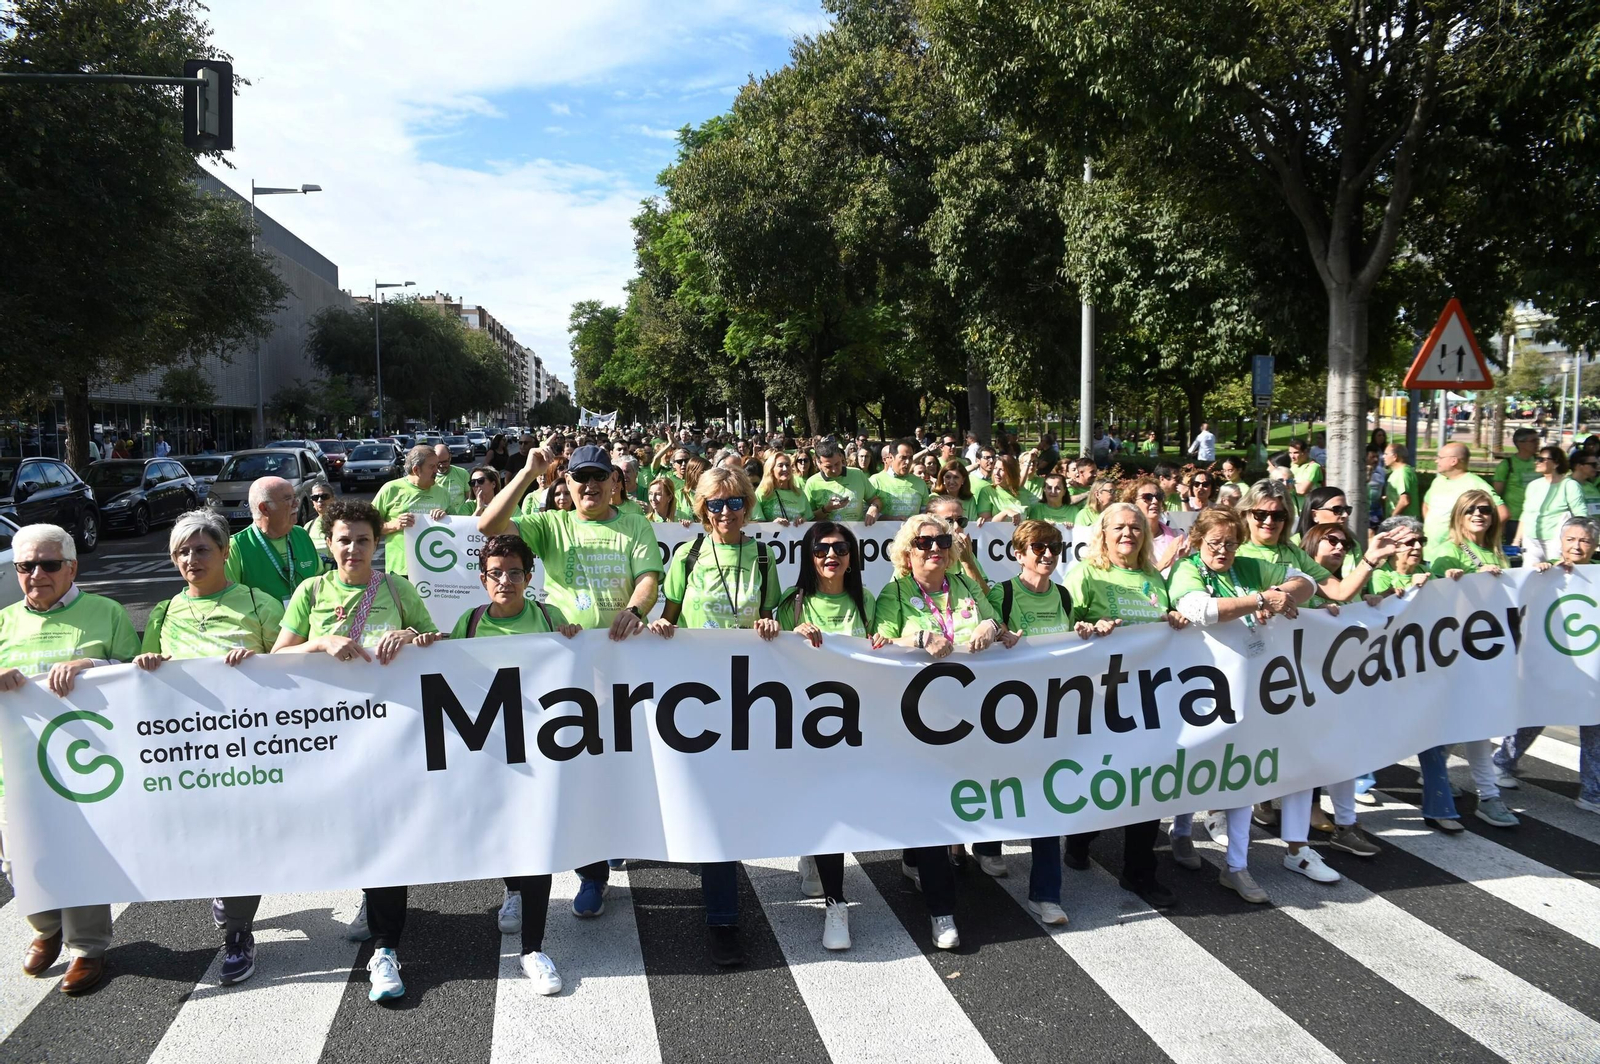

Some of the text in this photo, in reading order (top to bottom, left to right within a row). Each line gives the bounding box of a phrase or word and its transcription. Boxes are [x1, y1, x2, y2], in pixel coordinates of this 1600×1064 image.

[586, 551, 627, 562] marcha
[988, 539, 1088, 563] cora
[613, 563, 626, 575] el
[1118, 597, 1131, 605] En
[1120, 608, 1159, 619] contra
[364, 622, 396, 632] archa
[1041, 623, 1067, 634] march
[30, 648, 83, 659] marcha
[420, 605, 1527, 771] Marcha Contra el Cáncer
[137, 699, 387, 736] asociación española
[140, 734, 338, 764] contra el cáncer
[143, 765, 284, 792] en Córdoba
[950, 743, 1279, 822] en Córdoba
